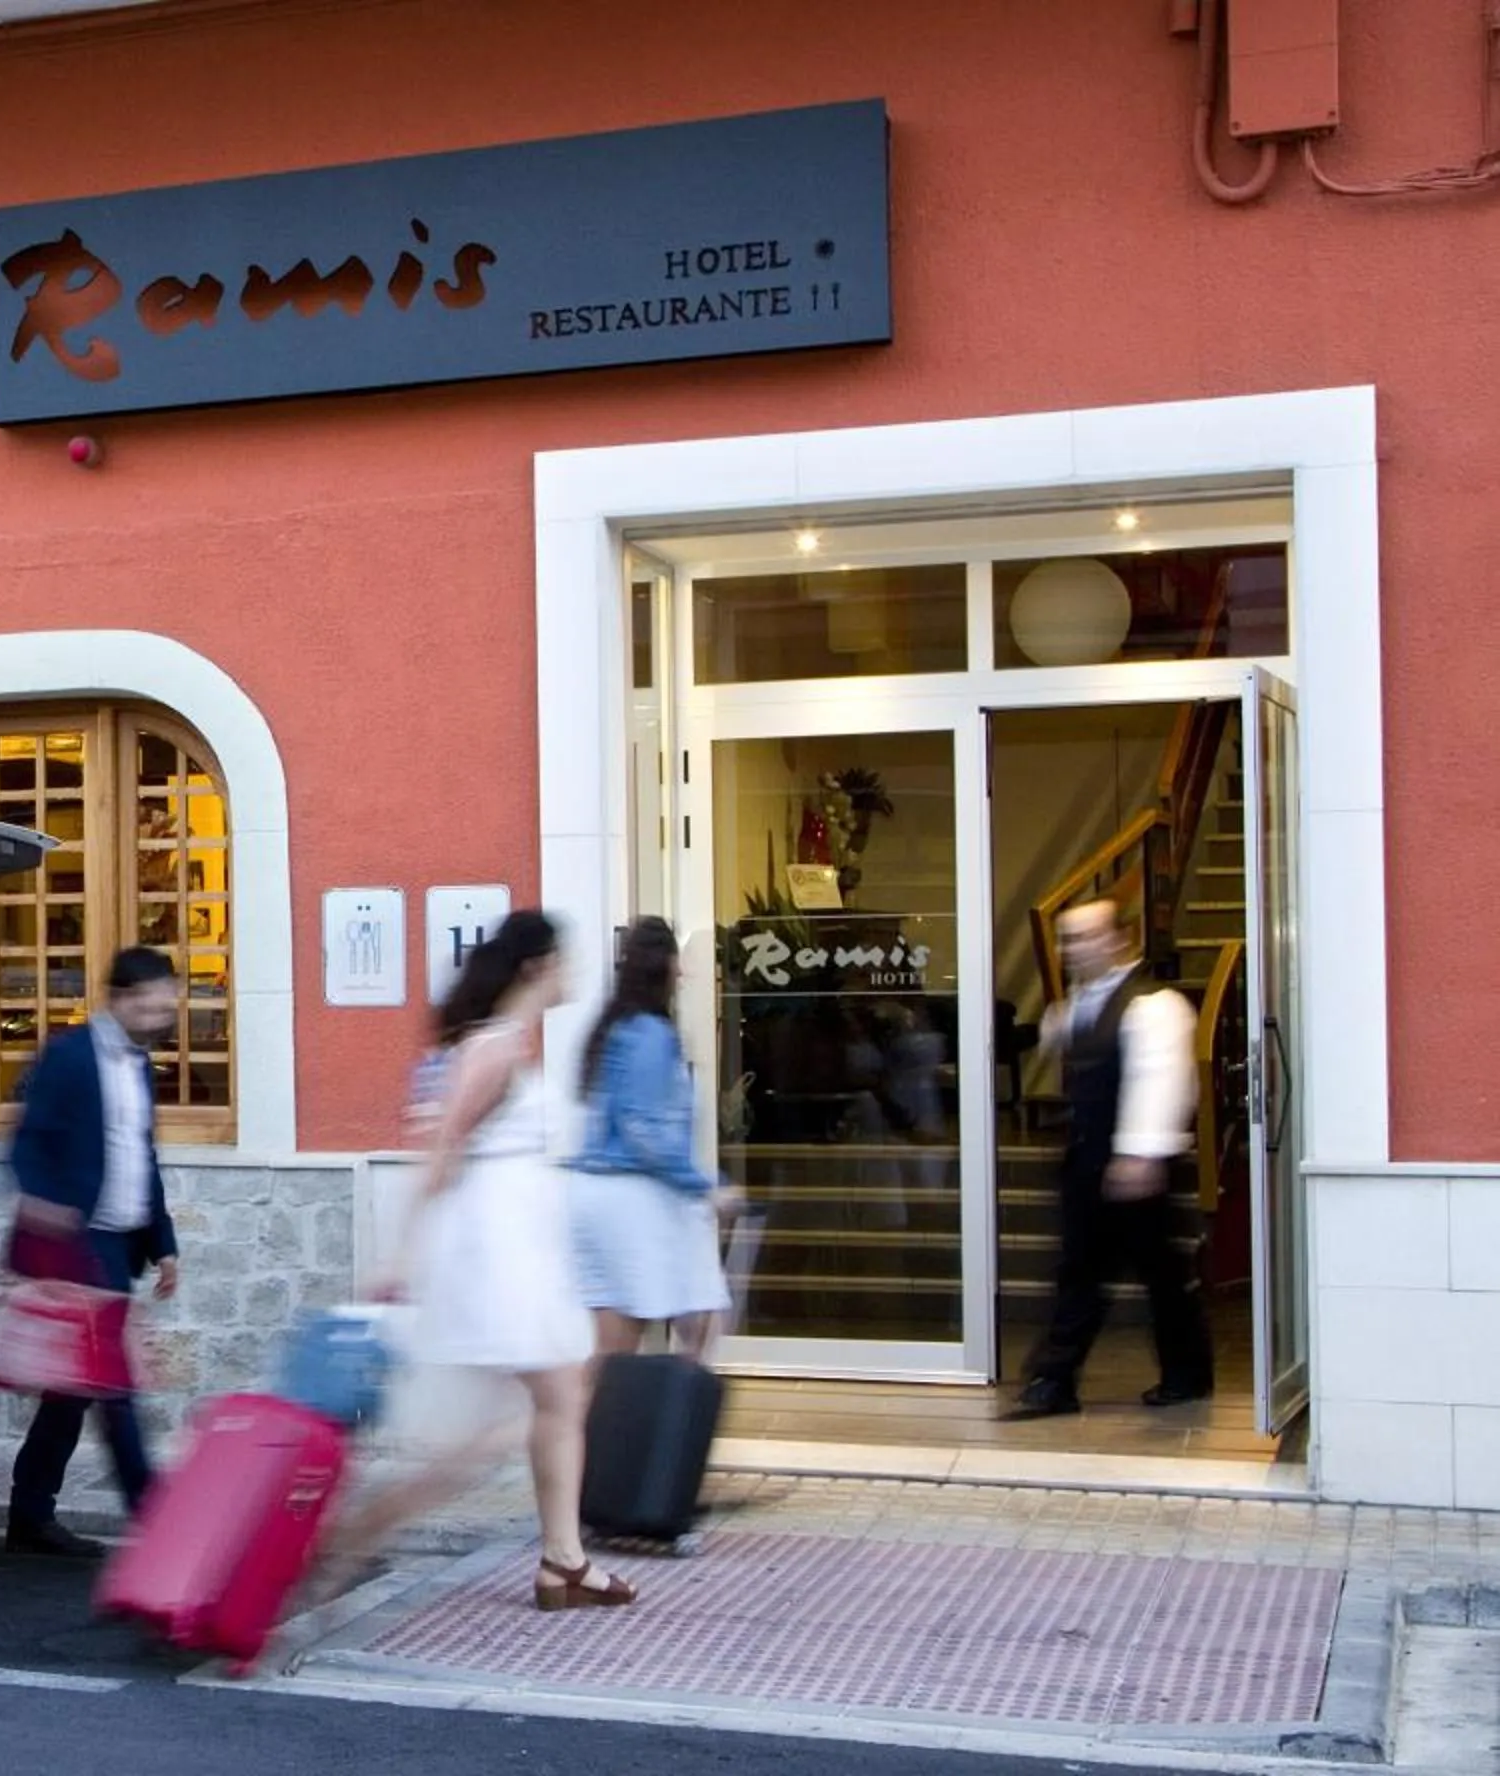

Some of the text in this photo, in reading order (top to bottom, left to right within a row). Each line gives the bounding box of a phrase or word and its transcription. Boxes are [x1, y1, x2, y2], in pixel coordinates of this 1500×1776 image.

[664, 240, 791, 280] HOTEL
[0, 217, 496, 383] Ramis
[529, 286, 792, 340] RESTAURANTE
[741, 930, 931, 986] Ramis
[870, 970, 931, 985] HOTEL
